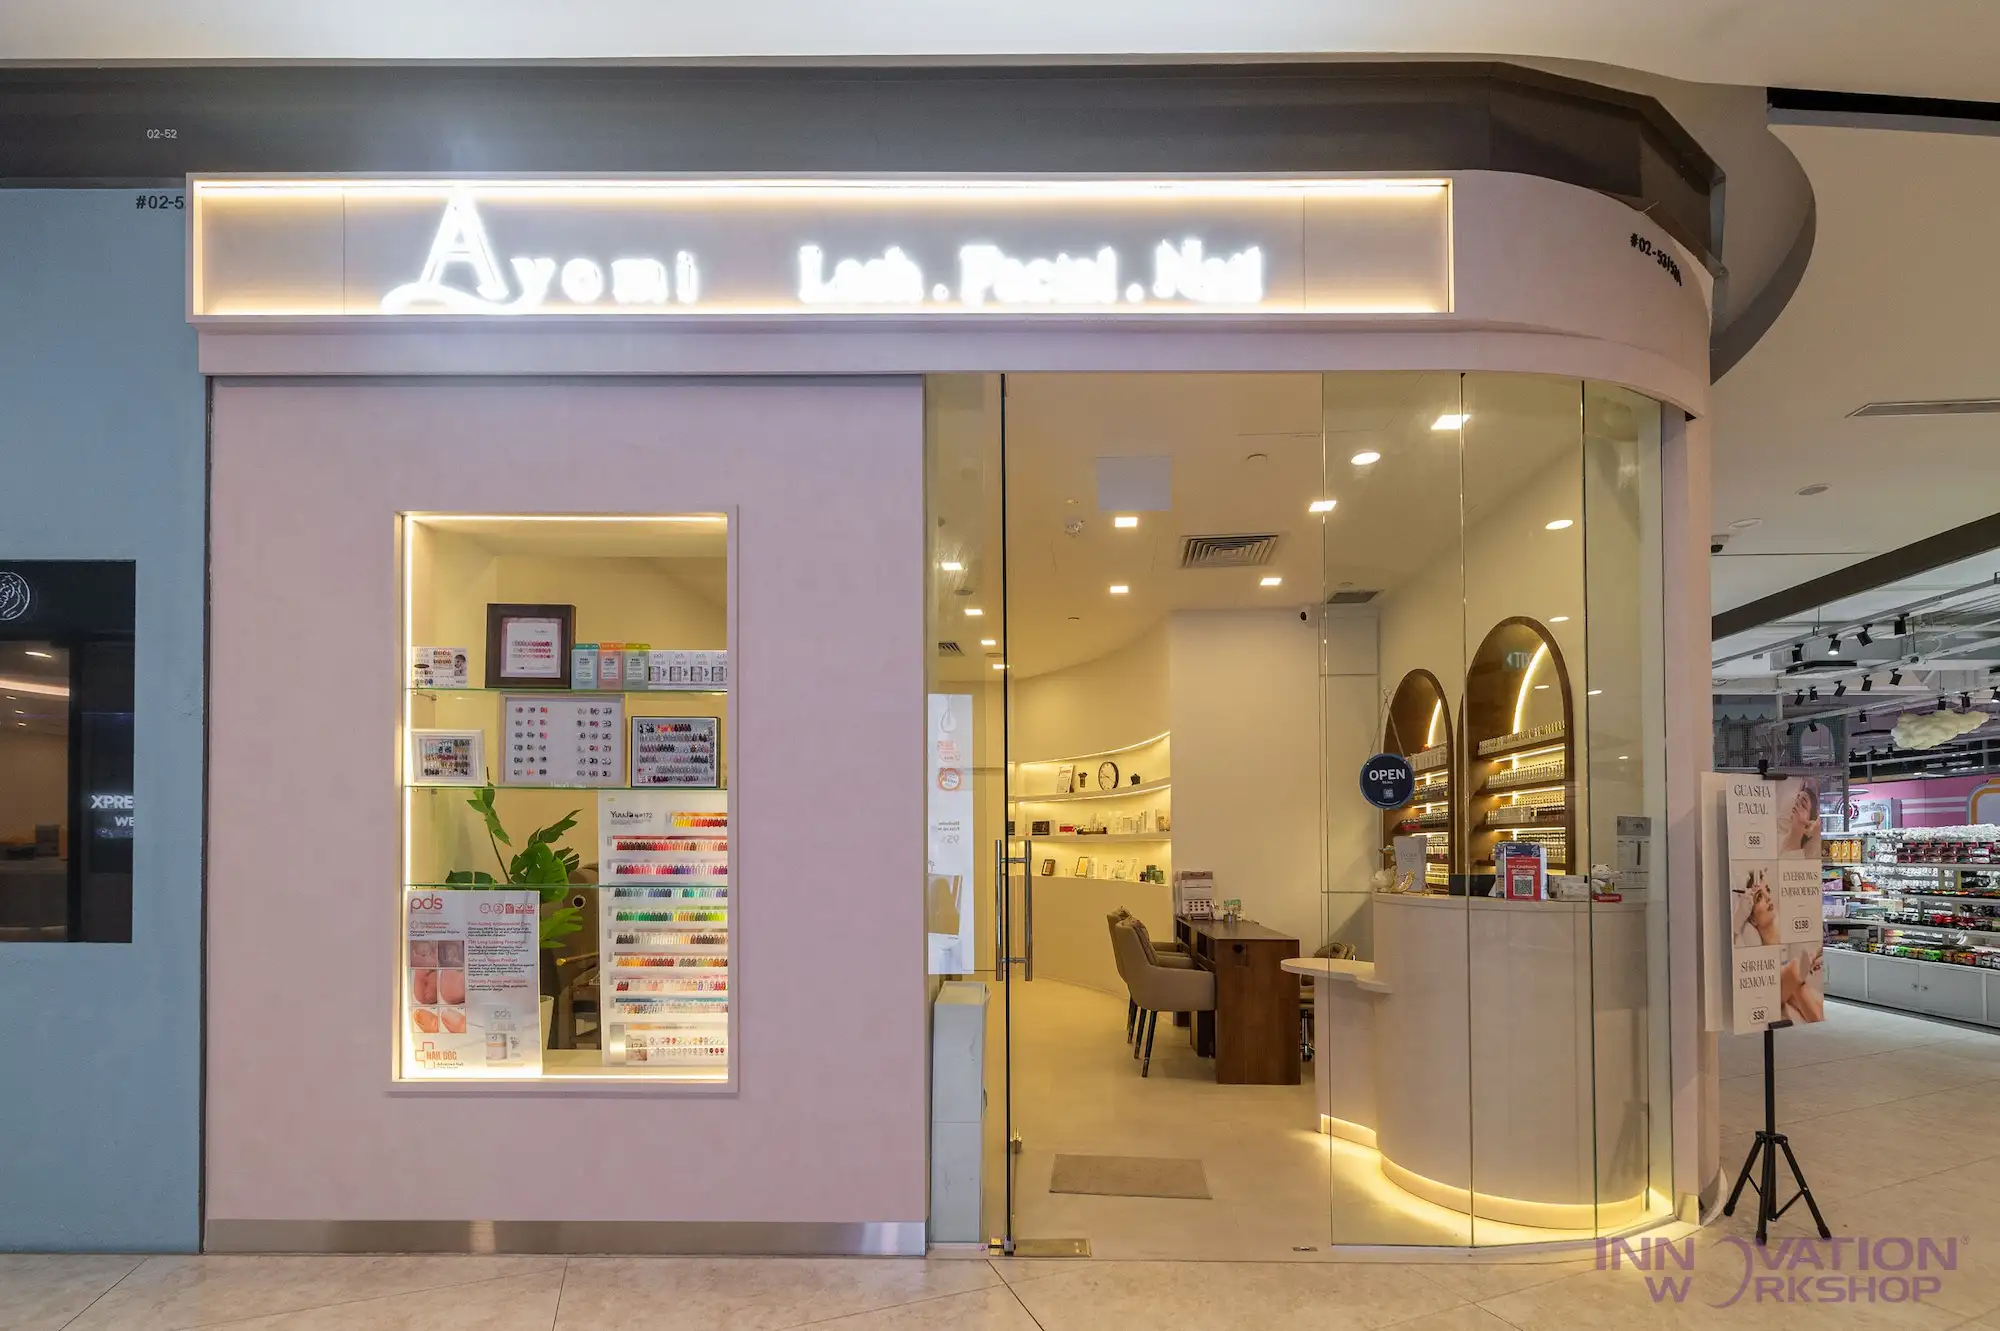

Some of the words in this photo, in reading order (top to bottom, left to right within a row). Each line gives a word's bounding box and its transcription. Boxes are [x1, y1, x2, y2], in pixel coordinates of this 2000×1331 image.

[146, 128, 178, 139] 02-52
[136, 195, 186, 210] #02-5
[379, 187, 699, 313] Ayomi
[1368, 769, 1405, 781] OPEN
[91, 795, 133, 809] XPRE
[1738, 802, 1769, 815] FACIAL
[115, 816, 135, 826] WE
[1783, 871, 1819, 881] EYEBROWS
[1781, 886, 1821, 897] EMBROIDERY
[410, 894, 443, 915] pds
[1739, 975, 1777, 990] REMOVAL
[426, 1051, 441, 1061] NAIL
